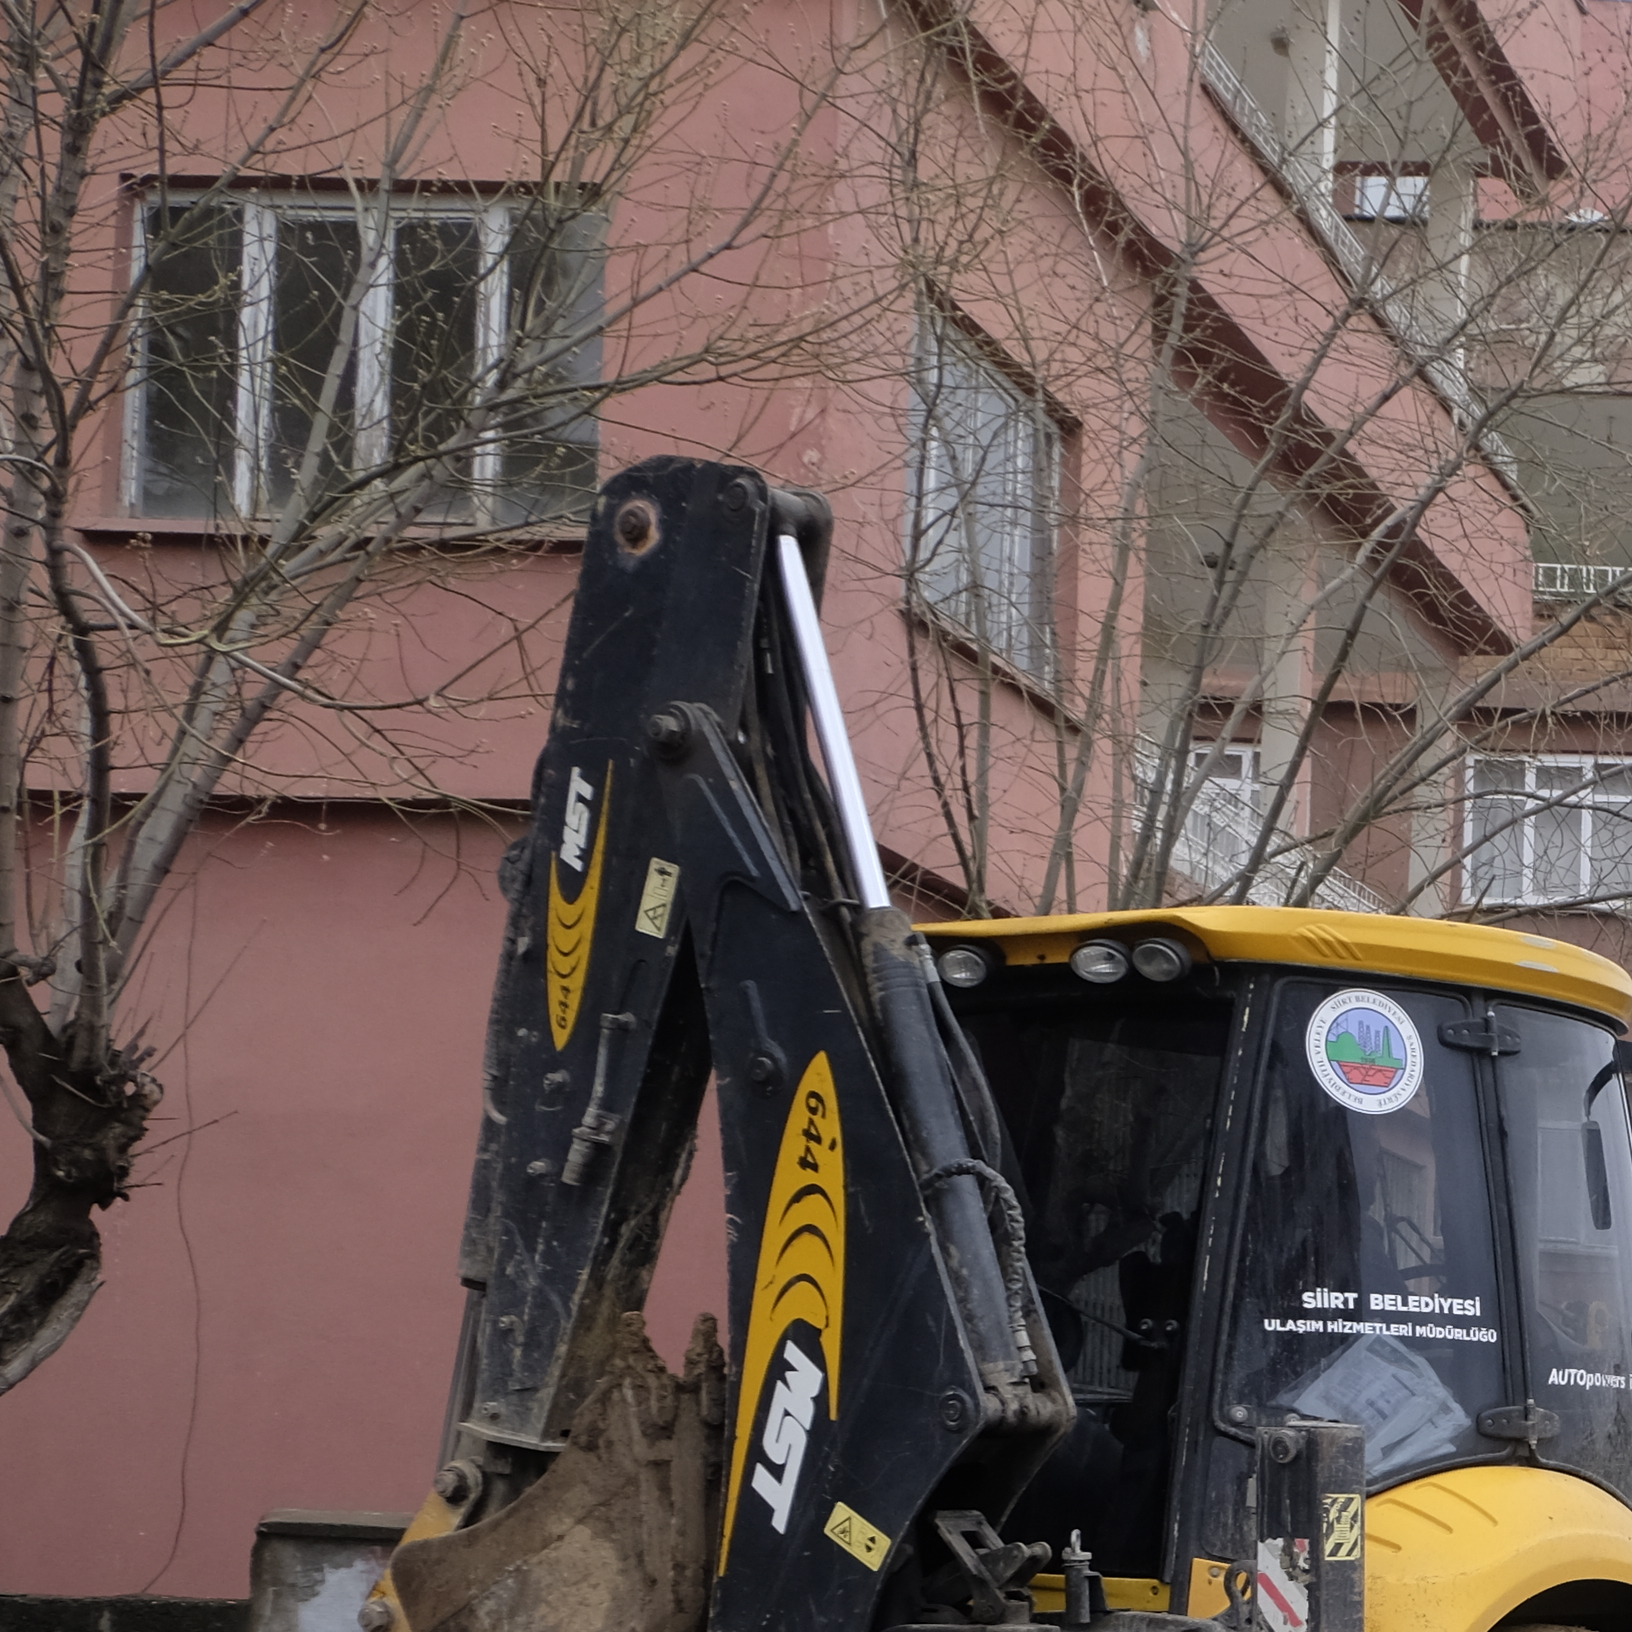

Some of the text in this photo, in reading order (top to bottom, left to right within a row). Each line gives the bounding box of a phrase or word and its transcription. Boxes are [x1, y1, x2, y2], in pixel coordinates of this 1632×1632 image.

[559, 766, 594, 873] MST
[556, 984, 571, 1030] 644
[797, 1090, 826, 1174] 644
[1263, 1318, 1498, 1343] ULAŞIM HİZMETLERİ MÜDÜRLÜĞÜ
[1301, 1288, 1482, 1317] SİİRT BELEDİYESİ
[751, 1339, 825, 1535] MST
